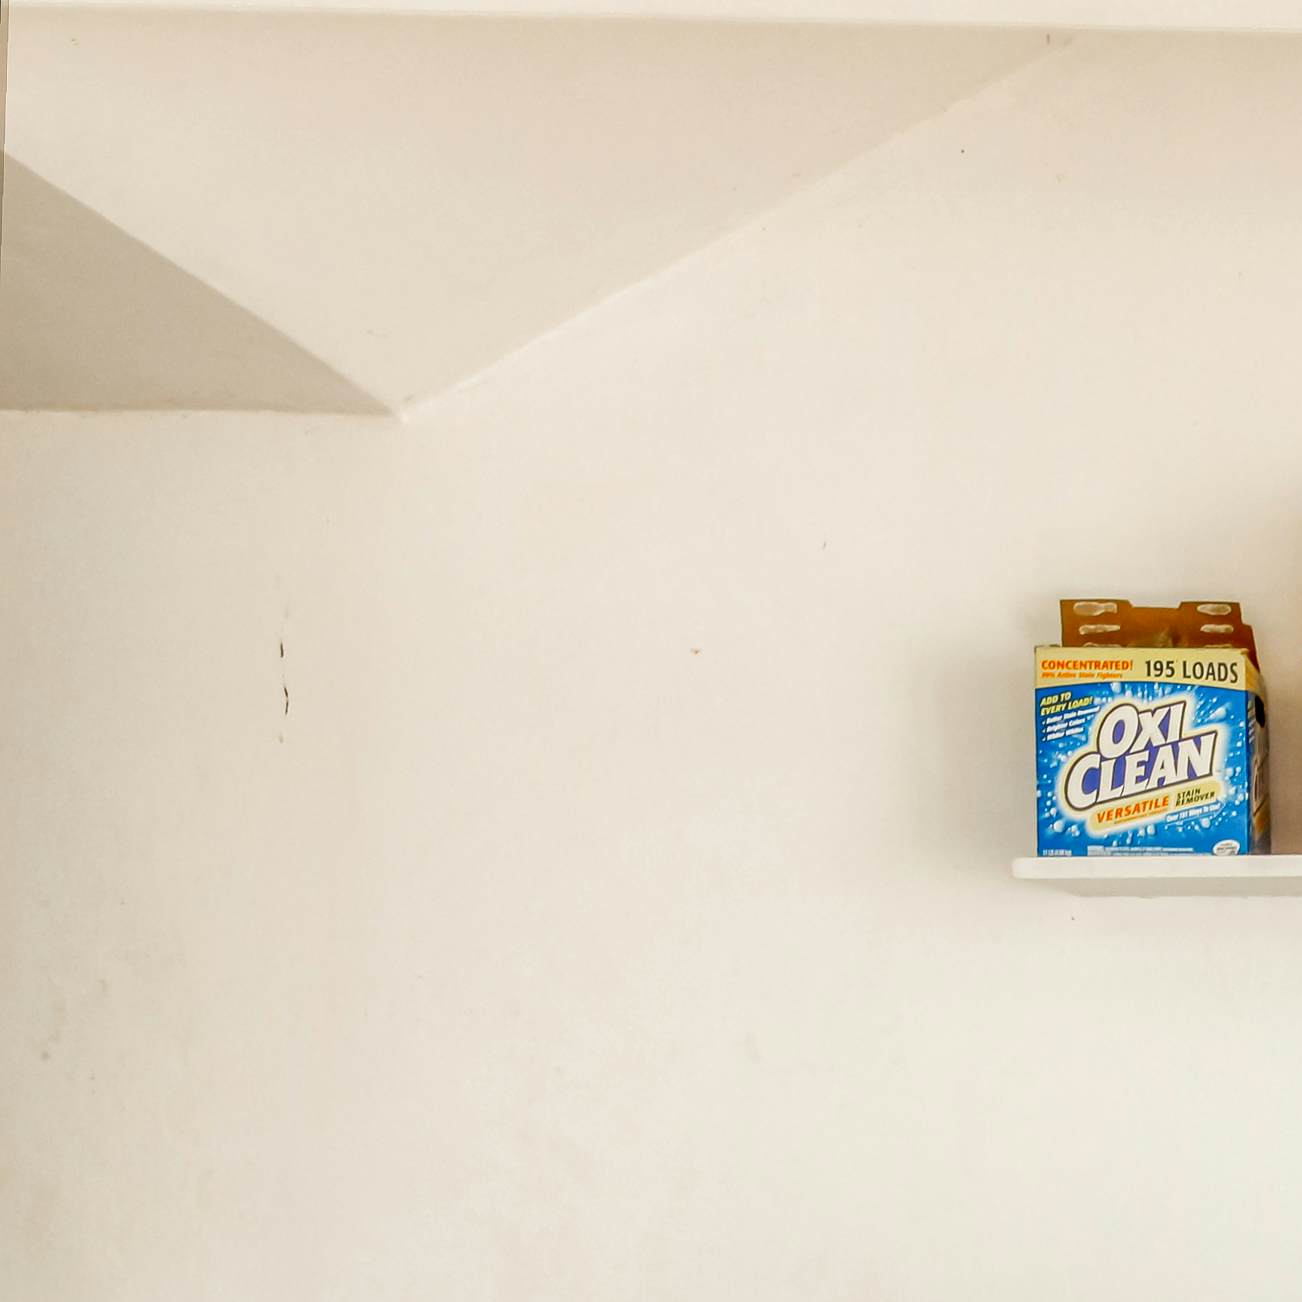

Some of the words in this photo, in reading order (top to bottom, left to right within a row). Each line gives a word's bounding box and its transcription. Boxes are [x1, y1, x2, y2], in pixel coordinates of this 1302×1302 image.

[1041, 660, 1133, 671] CONCENTRATED!
[1145, 660, 1175, 678] 195
[1182, 660, 1239, 684] LOADS
[1040, 693, 1059, 706] ADD
[1060, 691, 1072, 702] TO
[1040, 702, 1066, 716] EVERY
[1067, 696, 1093, 710] LOAD!
[1097, 700, 1186, 758] OXI
[1064, 729, 1218, 812] CLEAN
[1177, 788, 1201, 801] STAIN
[1096, 796, 1170, 824] VERSATILE
